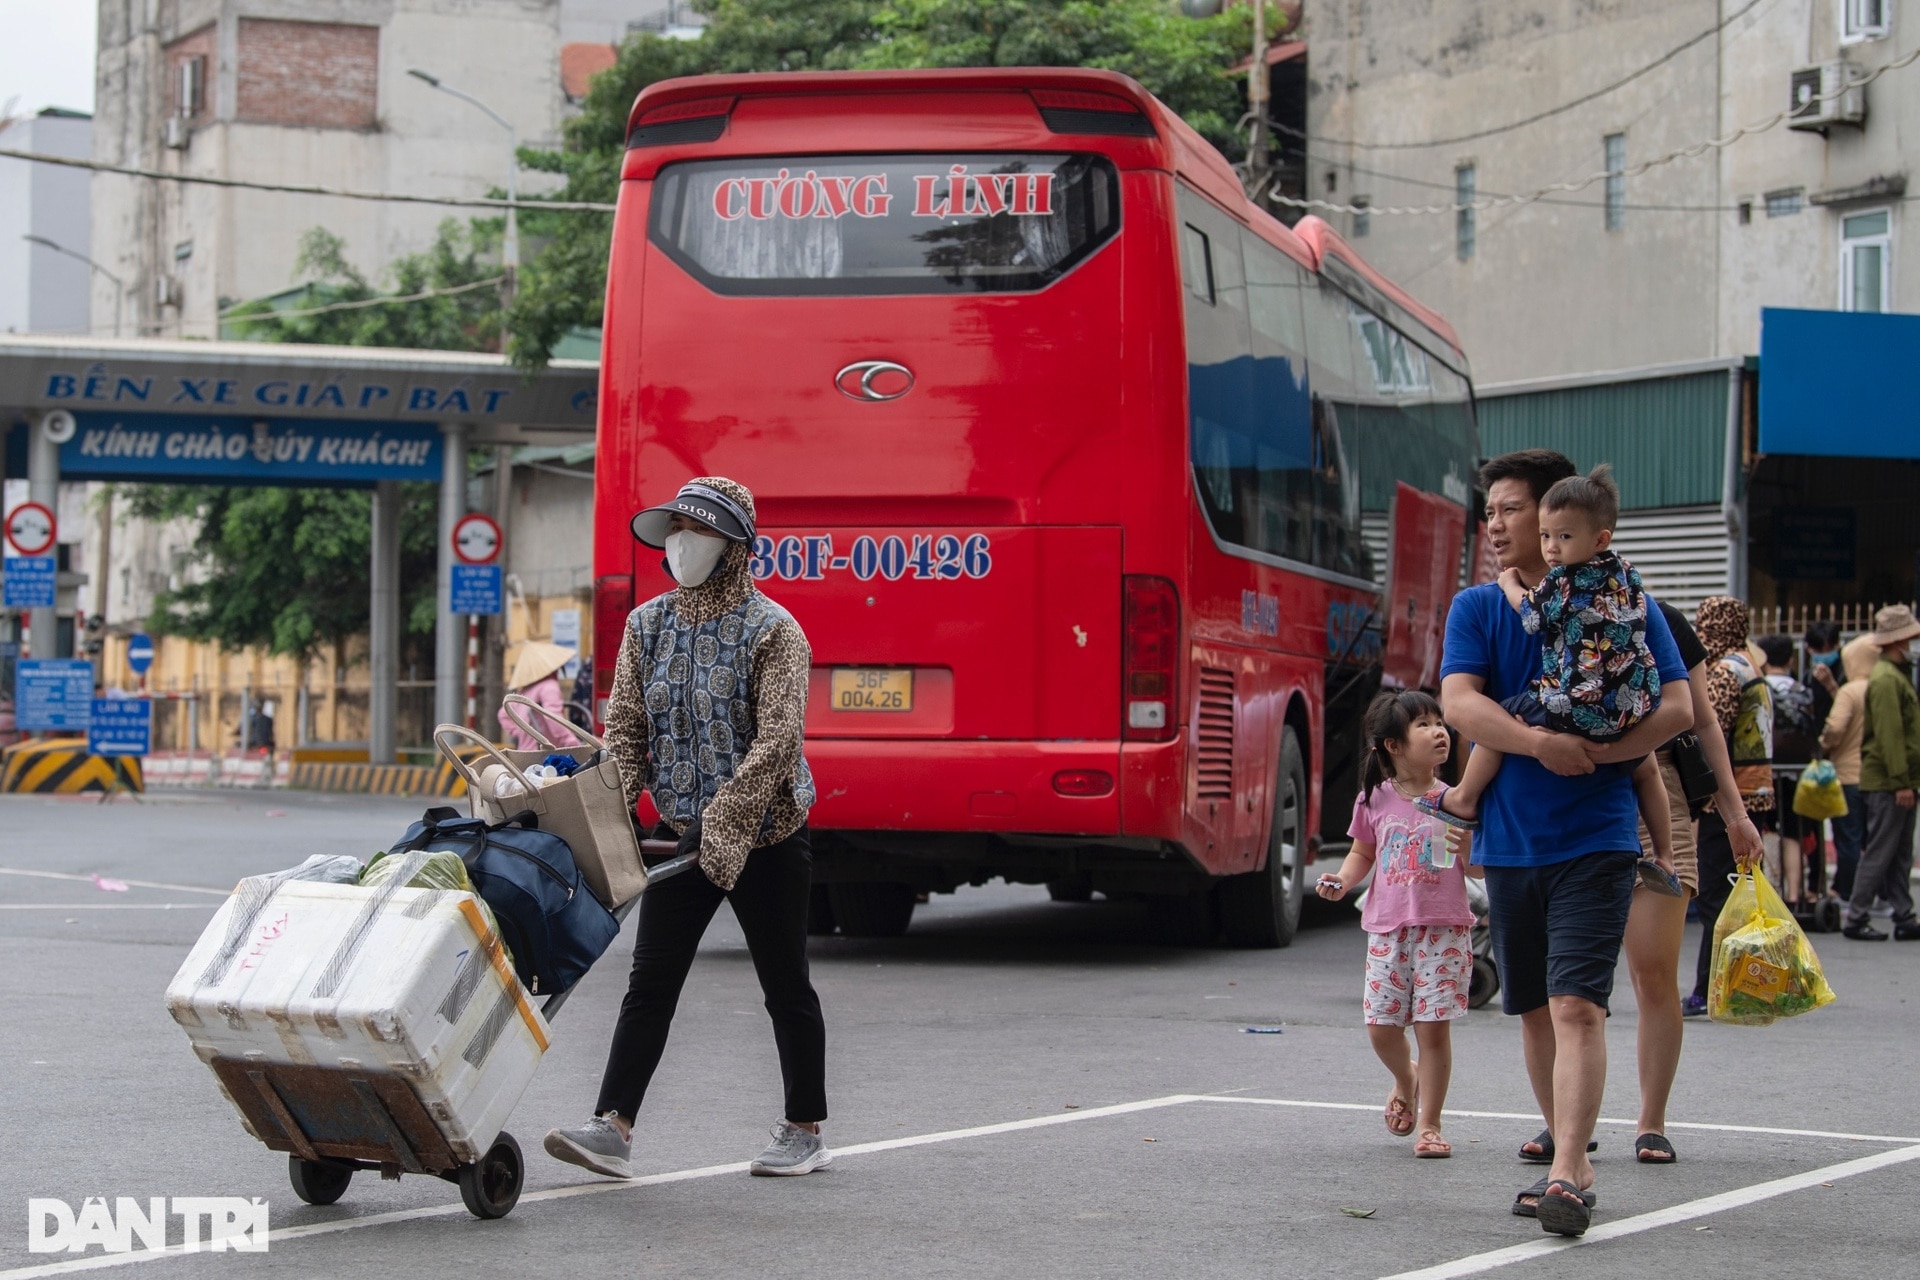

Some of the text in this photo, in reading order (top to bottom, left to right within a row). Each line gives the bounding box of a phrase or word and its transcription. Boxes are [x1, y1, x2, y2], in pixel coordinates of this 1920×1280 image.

[911, 164, 1055, 219] LĨNH
[46, 363, 510, 413] BẾN XE GIÁP BÁT
[80, 424, 161, 458] KÍNH
[164, 426, 248, 460] CHÀO
[317, 432, 432, 466] KHÁCH!
[678, 503, 717, 524] DIOR
[749, 534, 992, 581] 36F-00426
[841, 690, 903, 708] 004.26
[856, 672, 889, 689] 36F
